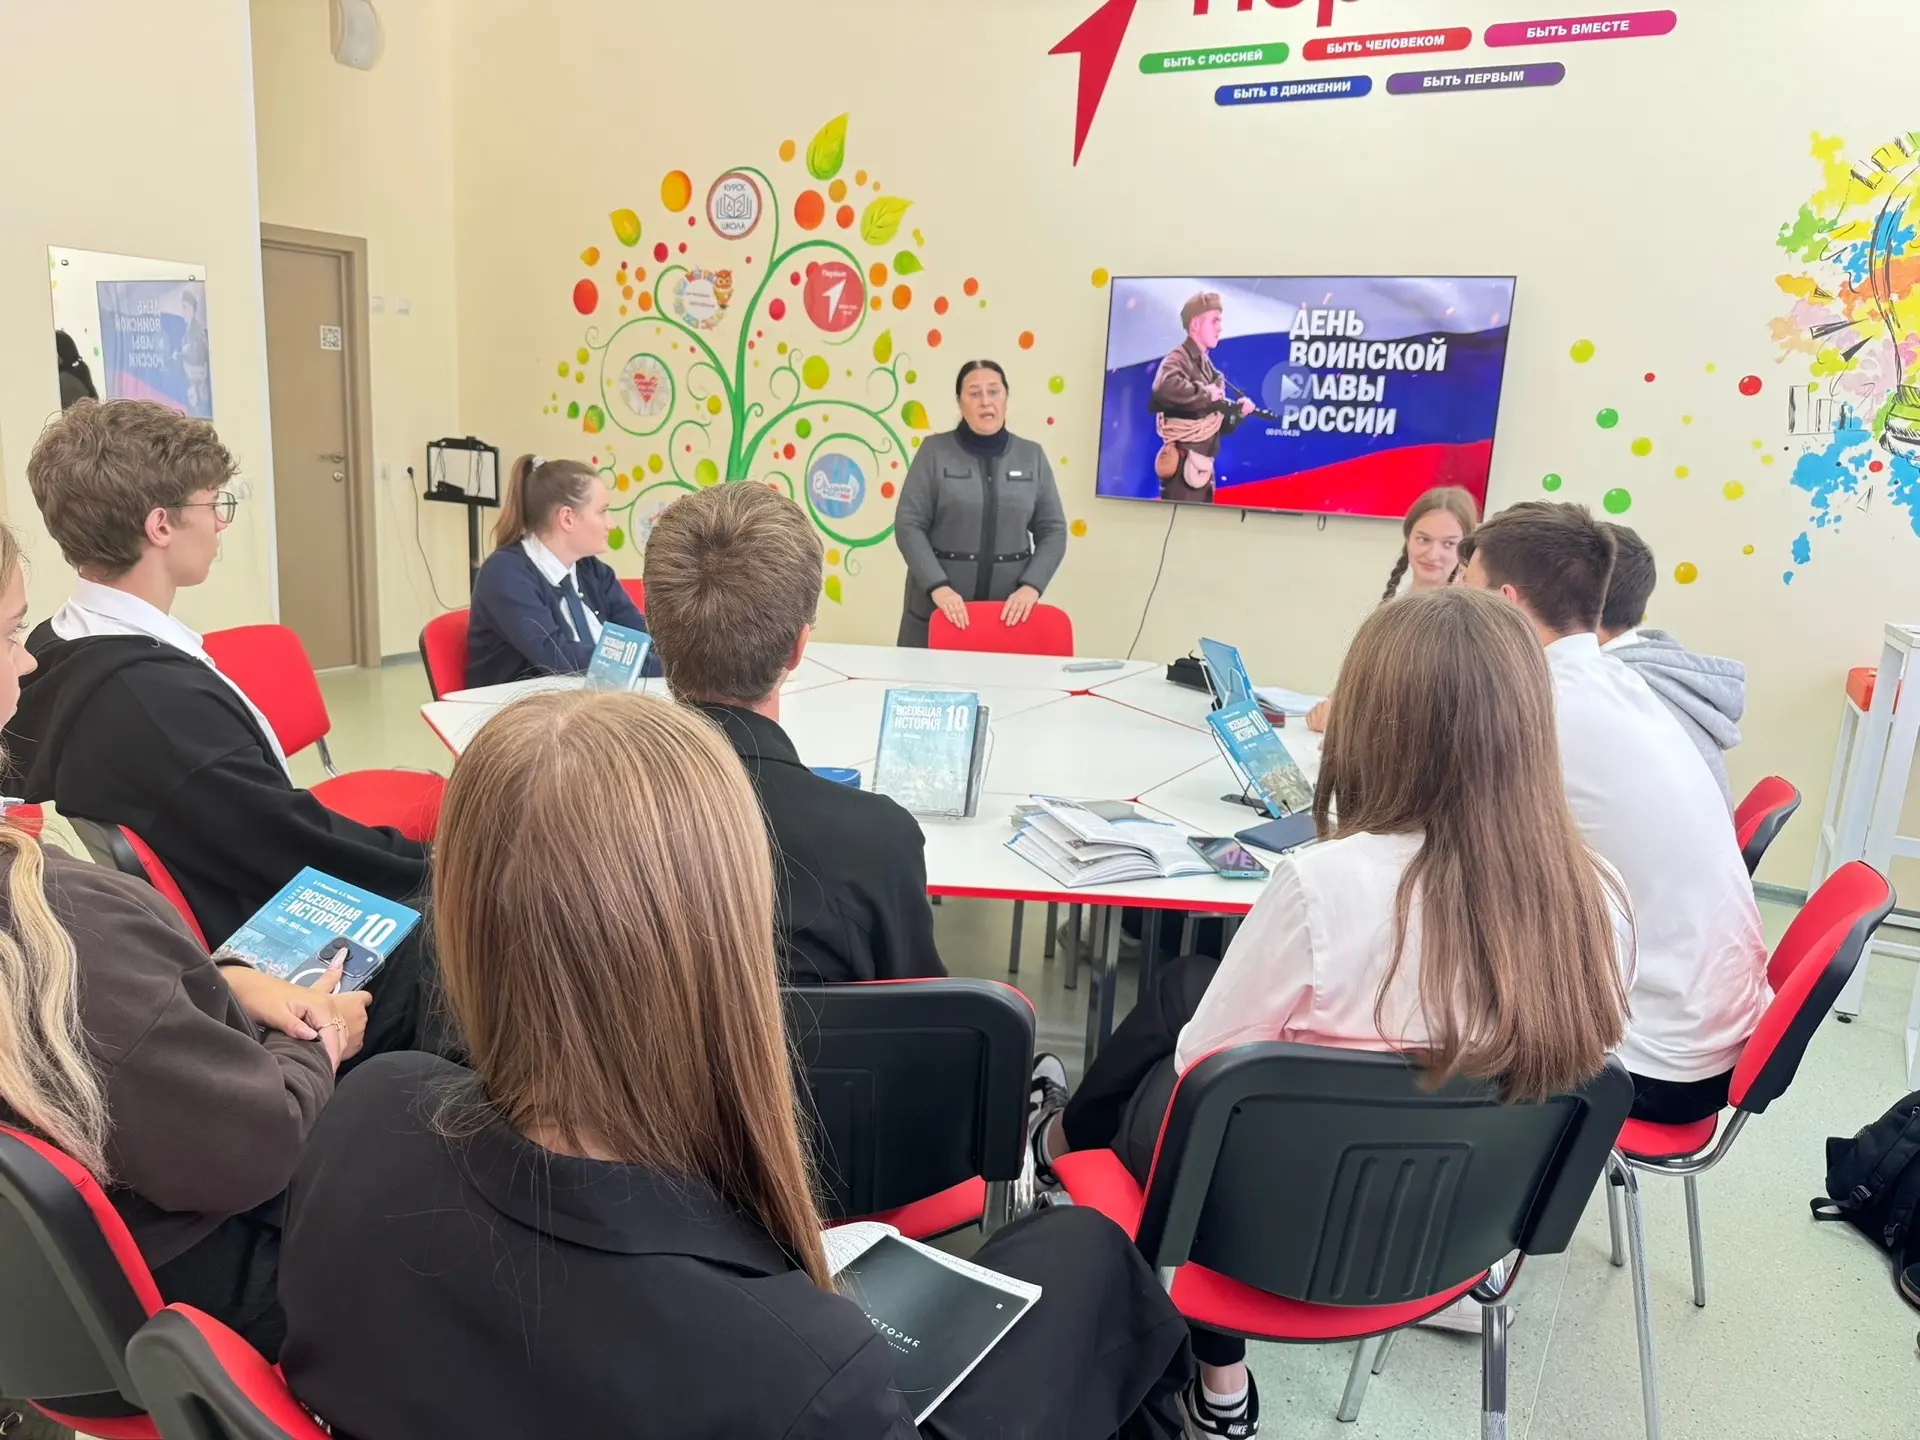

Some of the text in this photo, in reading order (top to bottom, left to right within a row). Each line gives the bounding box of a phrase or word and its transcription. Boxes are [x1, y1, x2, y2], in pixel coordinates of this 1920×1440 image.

[1526, 20, 1630, 38] БЫТЬ ВМЕСТЕ
[1326, 35, 1445, 54] БЫТЬ ЧЕЛОВЕКОМ
[1163, 49, 1263, 68] БЫТЬ С РОССИЕЙ
[1233, 81, 1351, 99] БЫТЬ В ДВИЖЕНИИ
[1423, 71, 1524, 87] БЫТЬ ПЕРВЫМ
[1289, 309, 1364, 340] ДЕНЬ
[1289, 337, 1447, 371] ВОИНСКОЙ
[1281, 404, 1397, 435] РОССИИ
[622, 641, 638, 666] 10
[894, 716, 941, 731] ИСТОРИЯ
[946, 704, 969, 731] 10
[284, 899, 352, 935] ИСТОРИЯ
[298, 888, 363, 921] ВСЕОБЩАЯ
[351, 913, 397, 948] 10
[1227, 1423, 1248, 1436] NIKE
